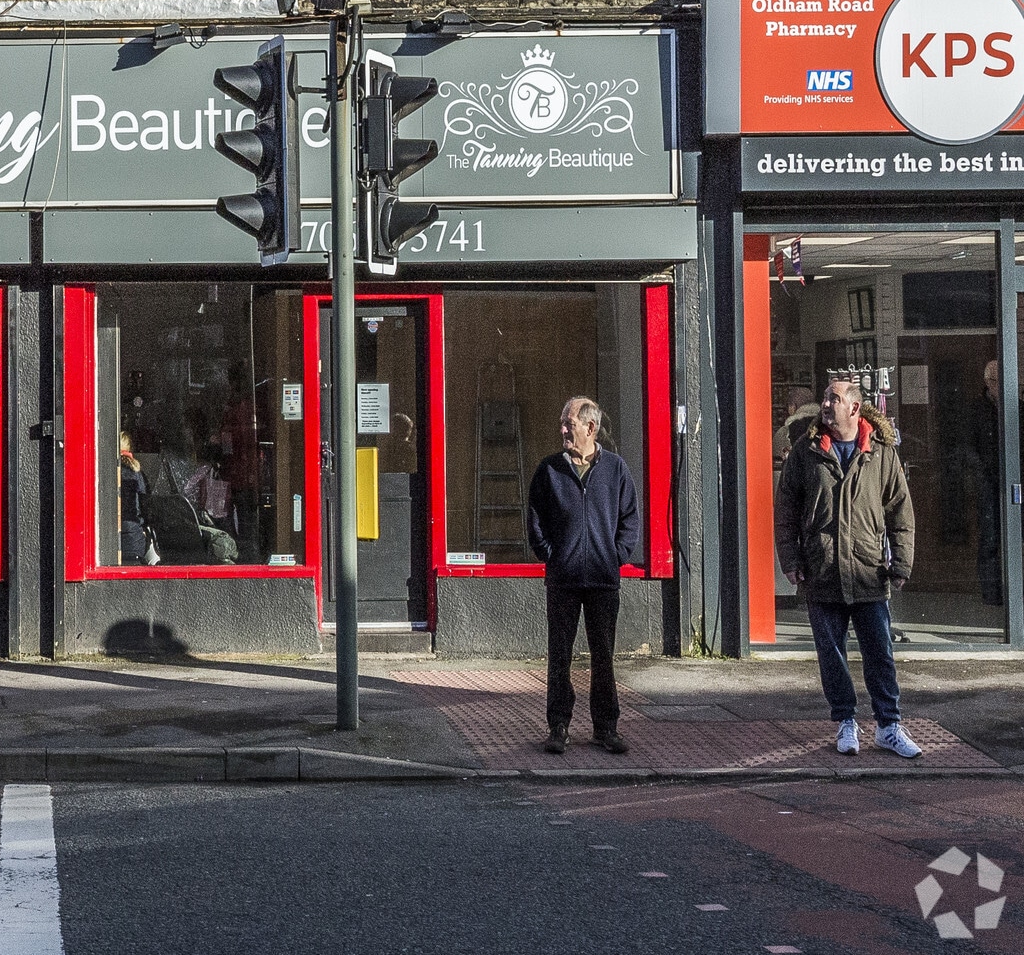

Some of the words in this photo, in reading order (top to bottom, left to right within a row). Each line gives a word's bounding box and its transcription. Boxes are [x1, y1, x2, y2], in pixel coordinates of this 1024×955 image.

[765, 21, 857, 39] Pharmacy
[901, 31, 1016, 79] KPS
[807, 70, 853, 91] NHS
[763, 94, 803, 106] Providing
[804, 94, 822, 104] NHS
[822, 95, 854, 104] services
[446, 154, 470, 169] The
[462, 139, 549, 178] Tanning
[549, 147, 634, 173] Beautique
[757, 153, 886, 177] delivering
[893, 152, 933, 173] the
[939, 151, 994, 173] best
